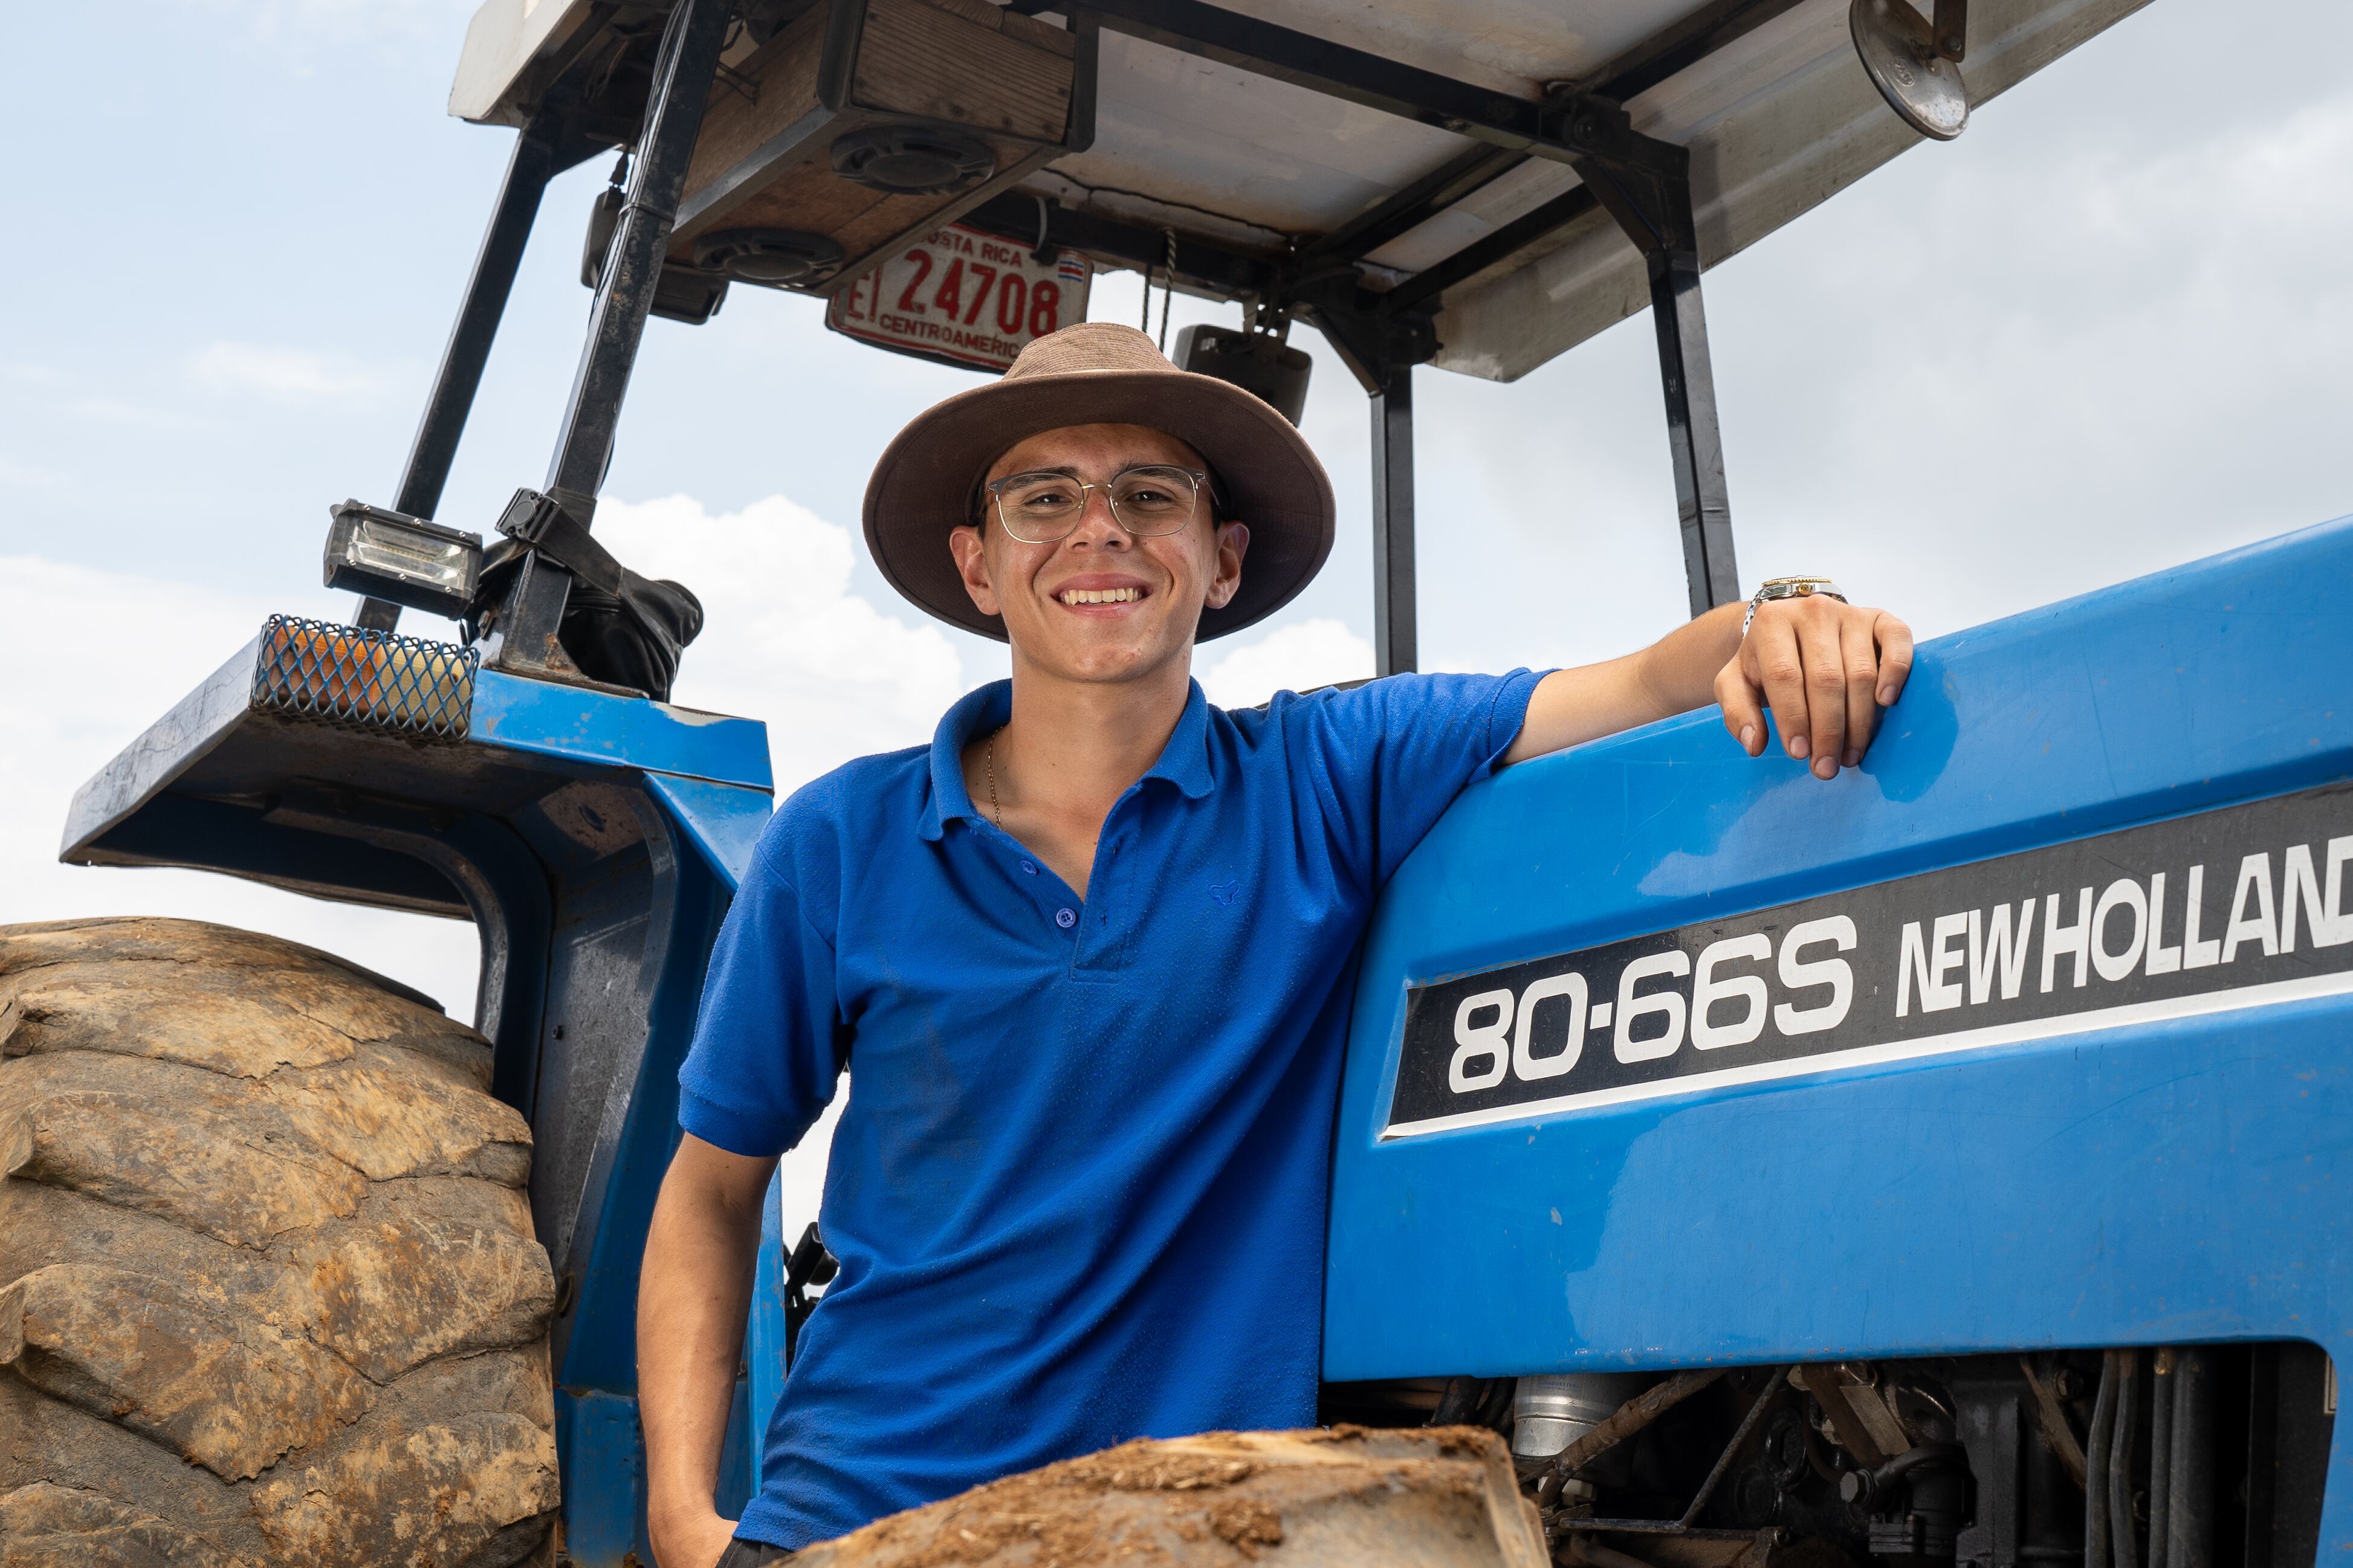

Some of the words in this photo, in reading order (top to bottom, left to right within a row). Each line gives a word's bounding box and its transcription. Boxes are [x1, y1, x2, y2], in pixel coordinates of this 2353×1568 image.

[898, 248, 1060, 340] 24708
[925, 230, 974, 257] OSTA
[980, 242, 1023, 269] RICA
[1449, 914, 1857, 1094] 80-66S
[1895, 897, 2036, 1018] NEW
